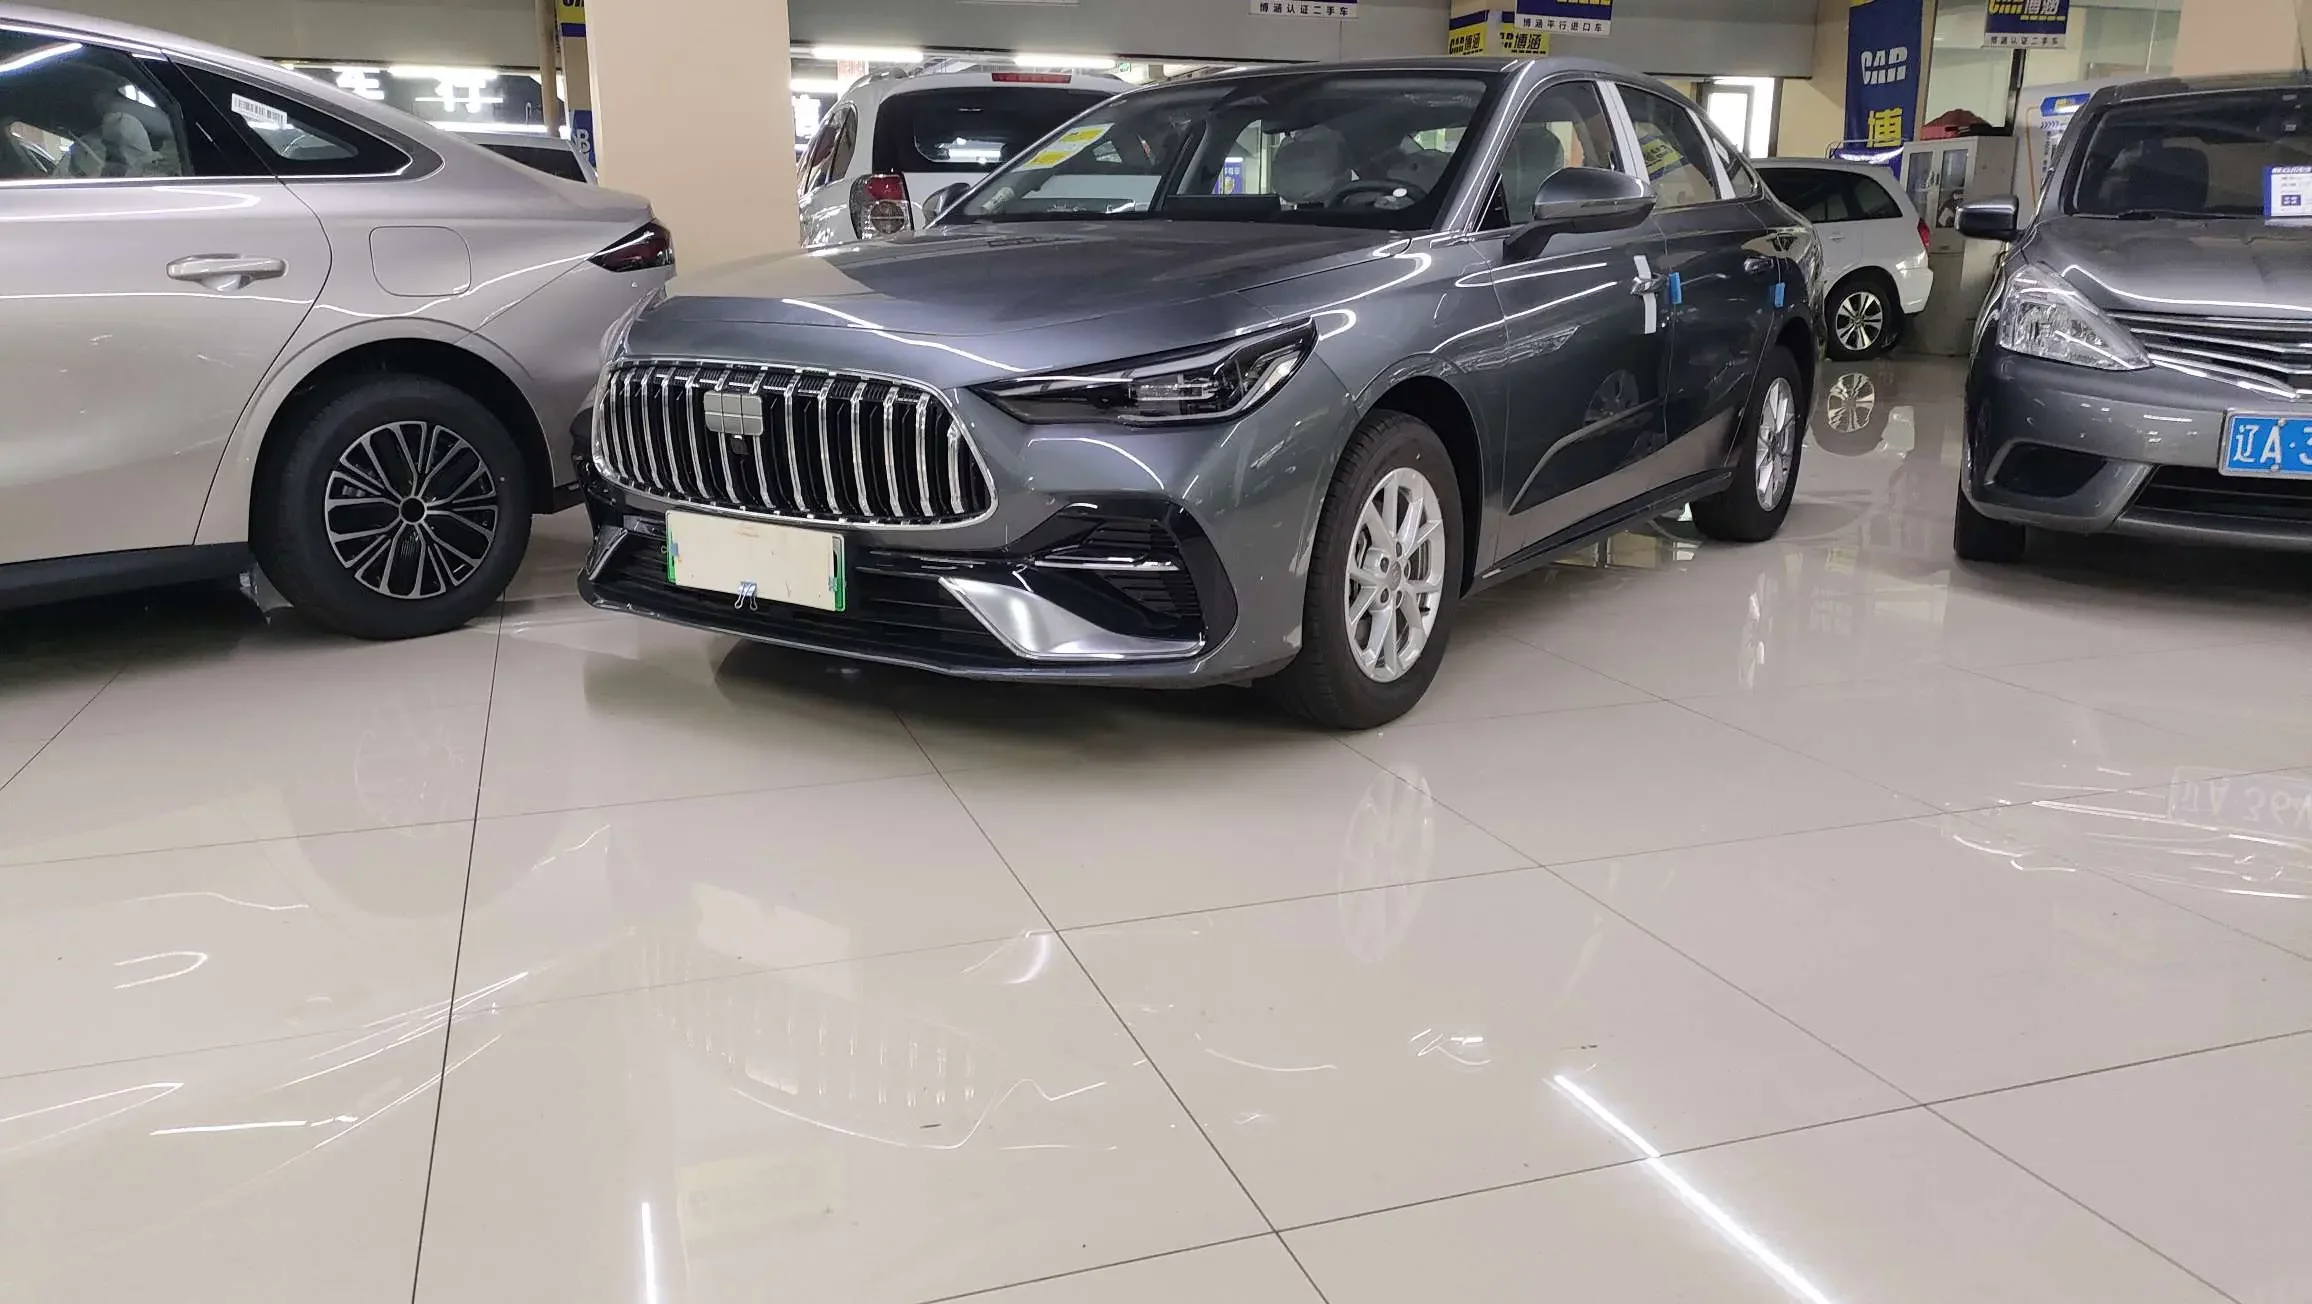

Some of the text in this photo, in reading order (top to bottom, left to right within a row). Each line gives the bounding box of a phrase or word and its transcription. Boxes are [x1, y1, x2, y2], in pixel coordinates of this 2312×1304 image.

[1260, 3, 1348, 16] 博涵认证二手车
[1523, 18, 1604, 32] 博涵平行进口车
[1861, 47, 1908, 85] CAR
[1866, 108, 1903, 148] 博
